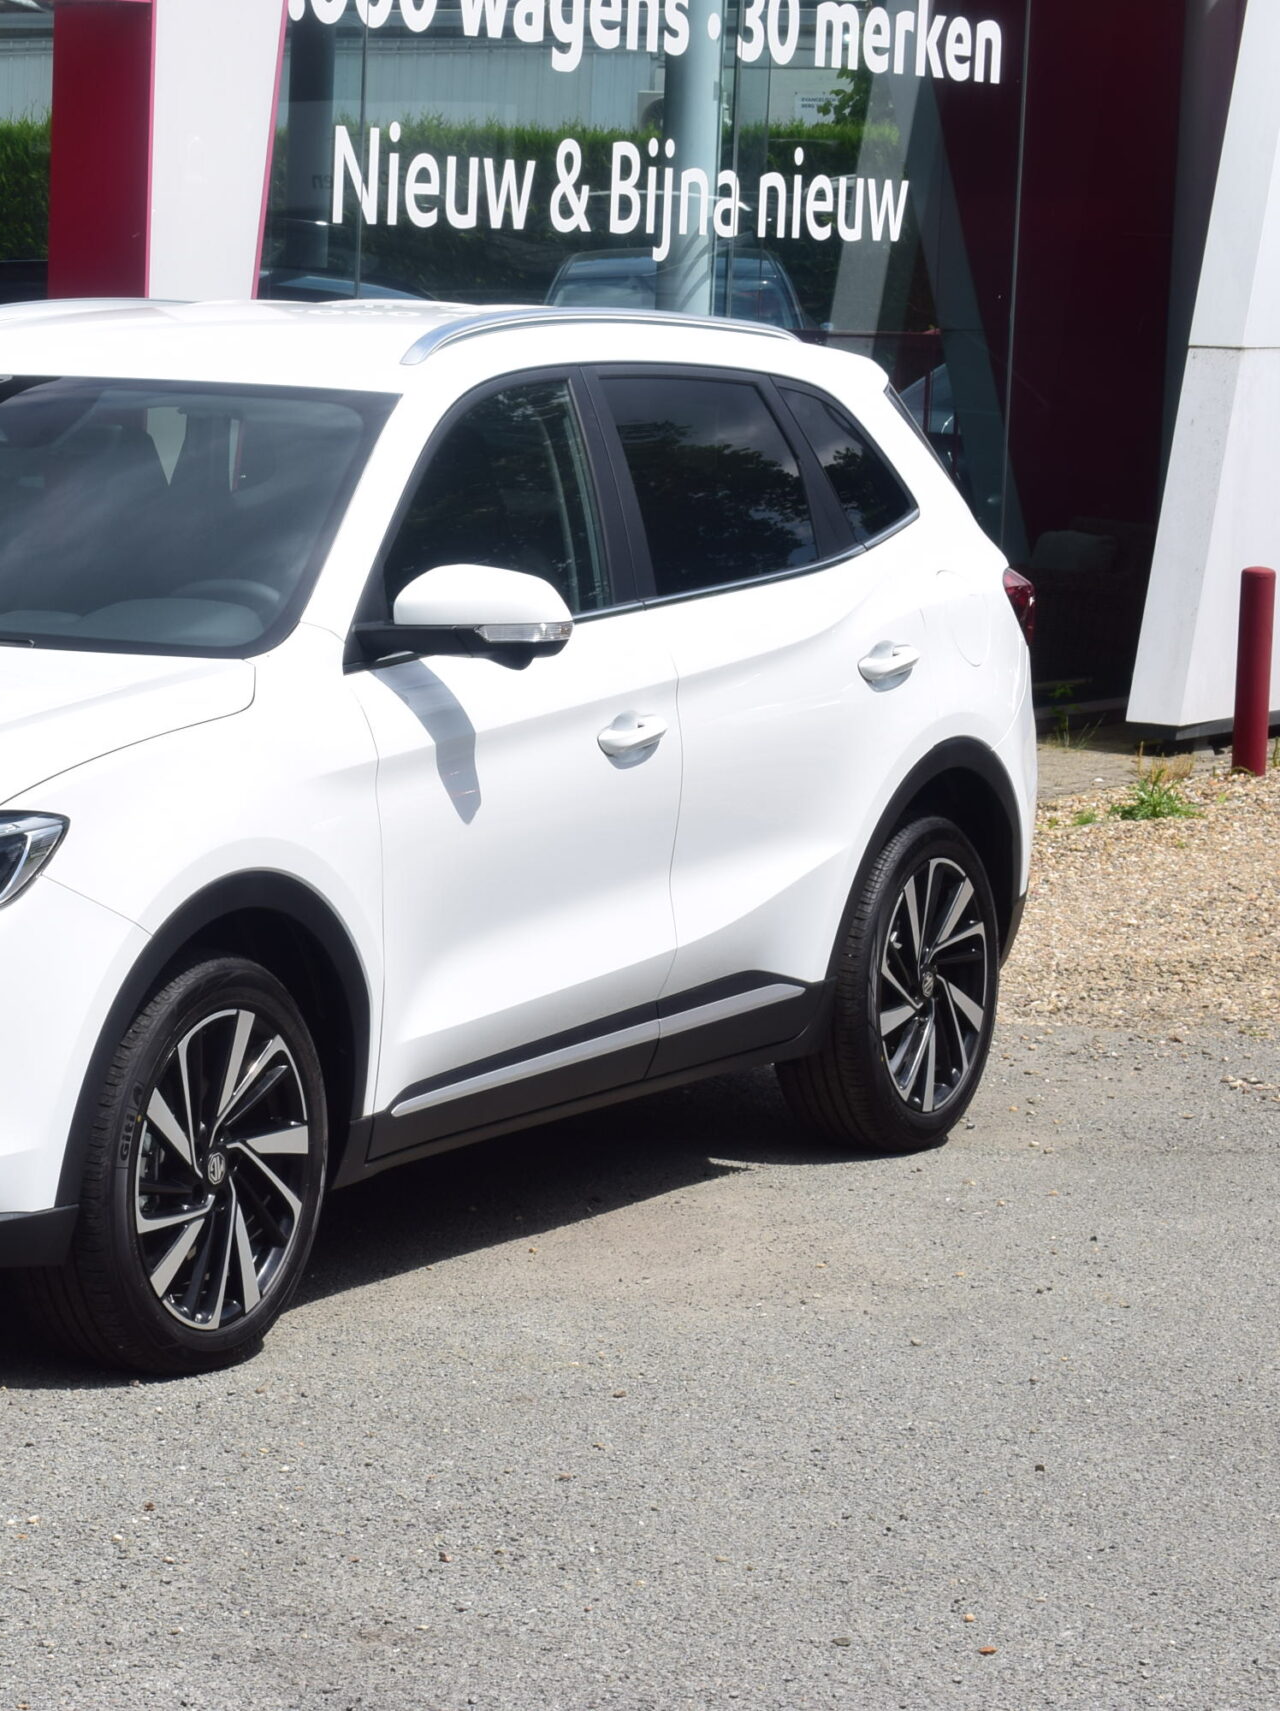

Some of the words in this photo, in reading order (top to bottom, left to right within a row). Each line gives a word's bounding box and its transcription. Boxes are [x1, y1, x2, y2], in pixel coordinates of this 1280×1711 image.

[460, 0, 690, 73] wagens
[737, 0, 800, 65] 30
[814, 0, 1002, 84] merken
[332, 121, 536, 230] Nieuw
[550, 138, 591, 233] &
[609, 138, 749, 262] Bijna
[757, 147, 909, 243] nieuw
